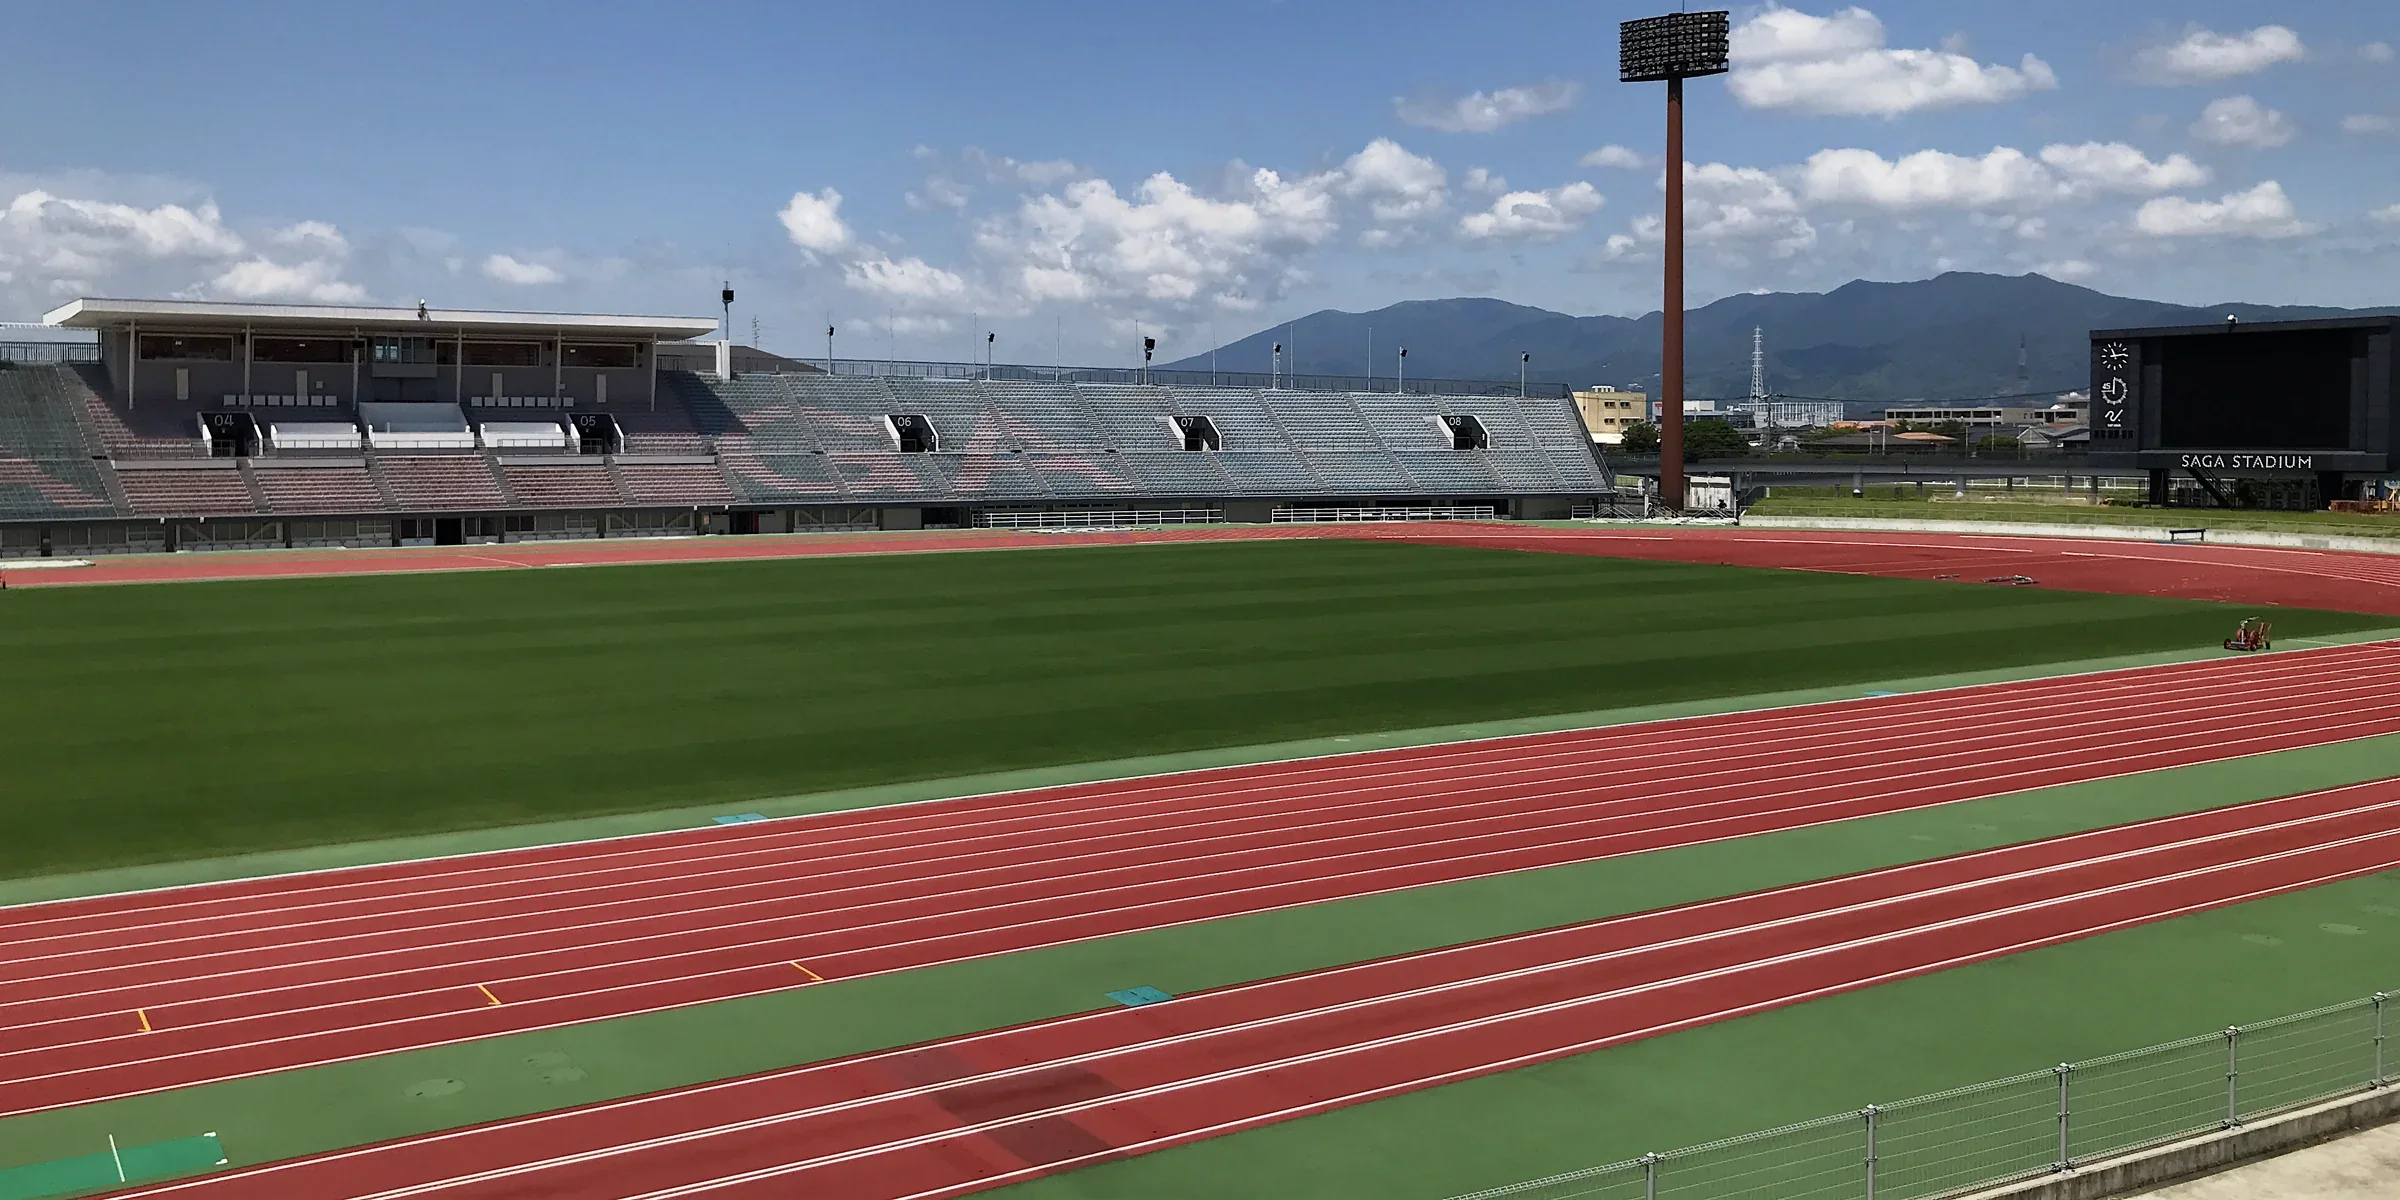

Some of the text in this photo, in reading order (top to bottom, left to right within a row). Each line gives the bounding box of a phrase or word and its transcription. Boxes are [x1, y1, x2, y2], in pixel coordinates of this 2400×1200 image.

[214, 414, 235, 427] 04
[580, 415, 597, 427] 05
[897, 416, 912, 427] 06
[1180, 417, 1195, 428] 07
[1448, 416, 1462, 426] 08
[2181, 454, 2312, 469] SAGA STADIUM
